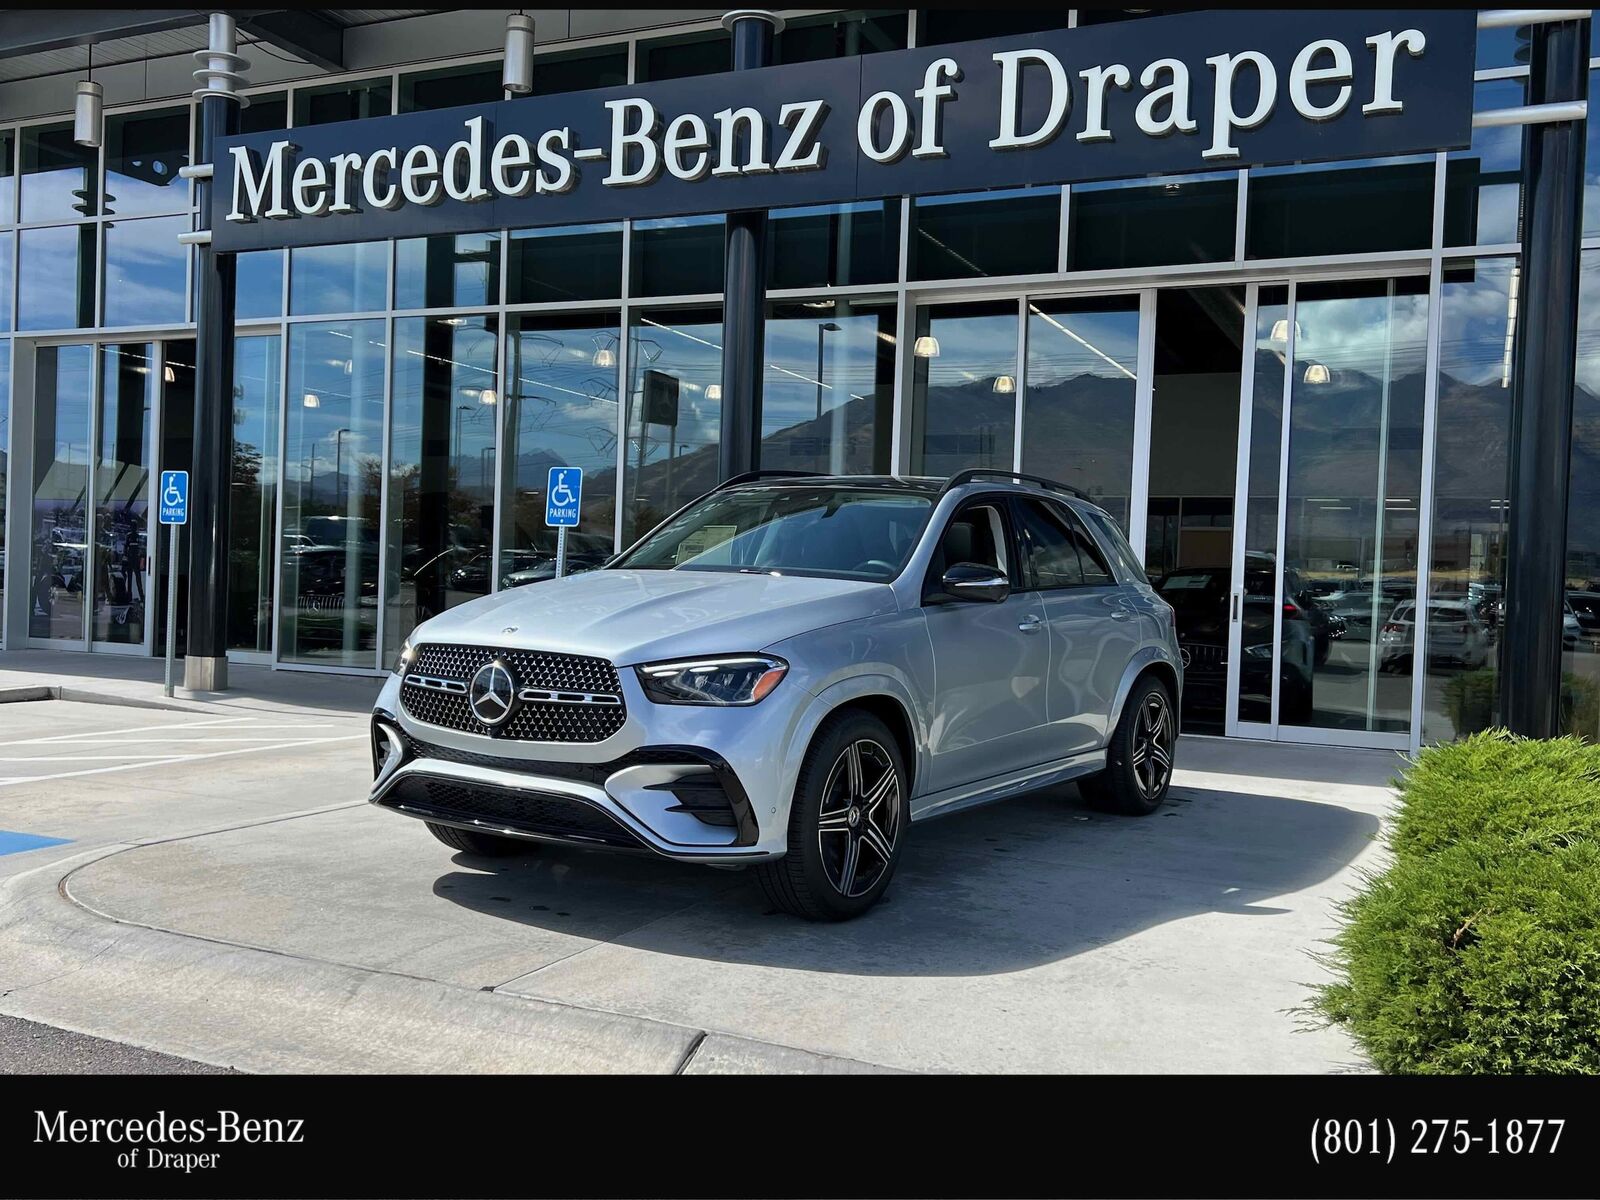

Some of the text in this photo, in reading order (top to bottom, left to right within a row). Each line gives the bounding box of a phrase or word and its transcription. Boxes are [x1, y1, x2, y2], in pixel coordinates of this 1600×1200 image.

[225, 29, 1426, 222] Mercedes-Benz of Draper
[162, 507, 184, 517] PARKING
[549, 507, 576, 518] PARKING
